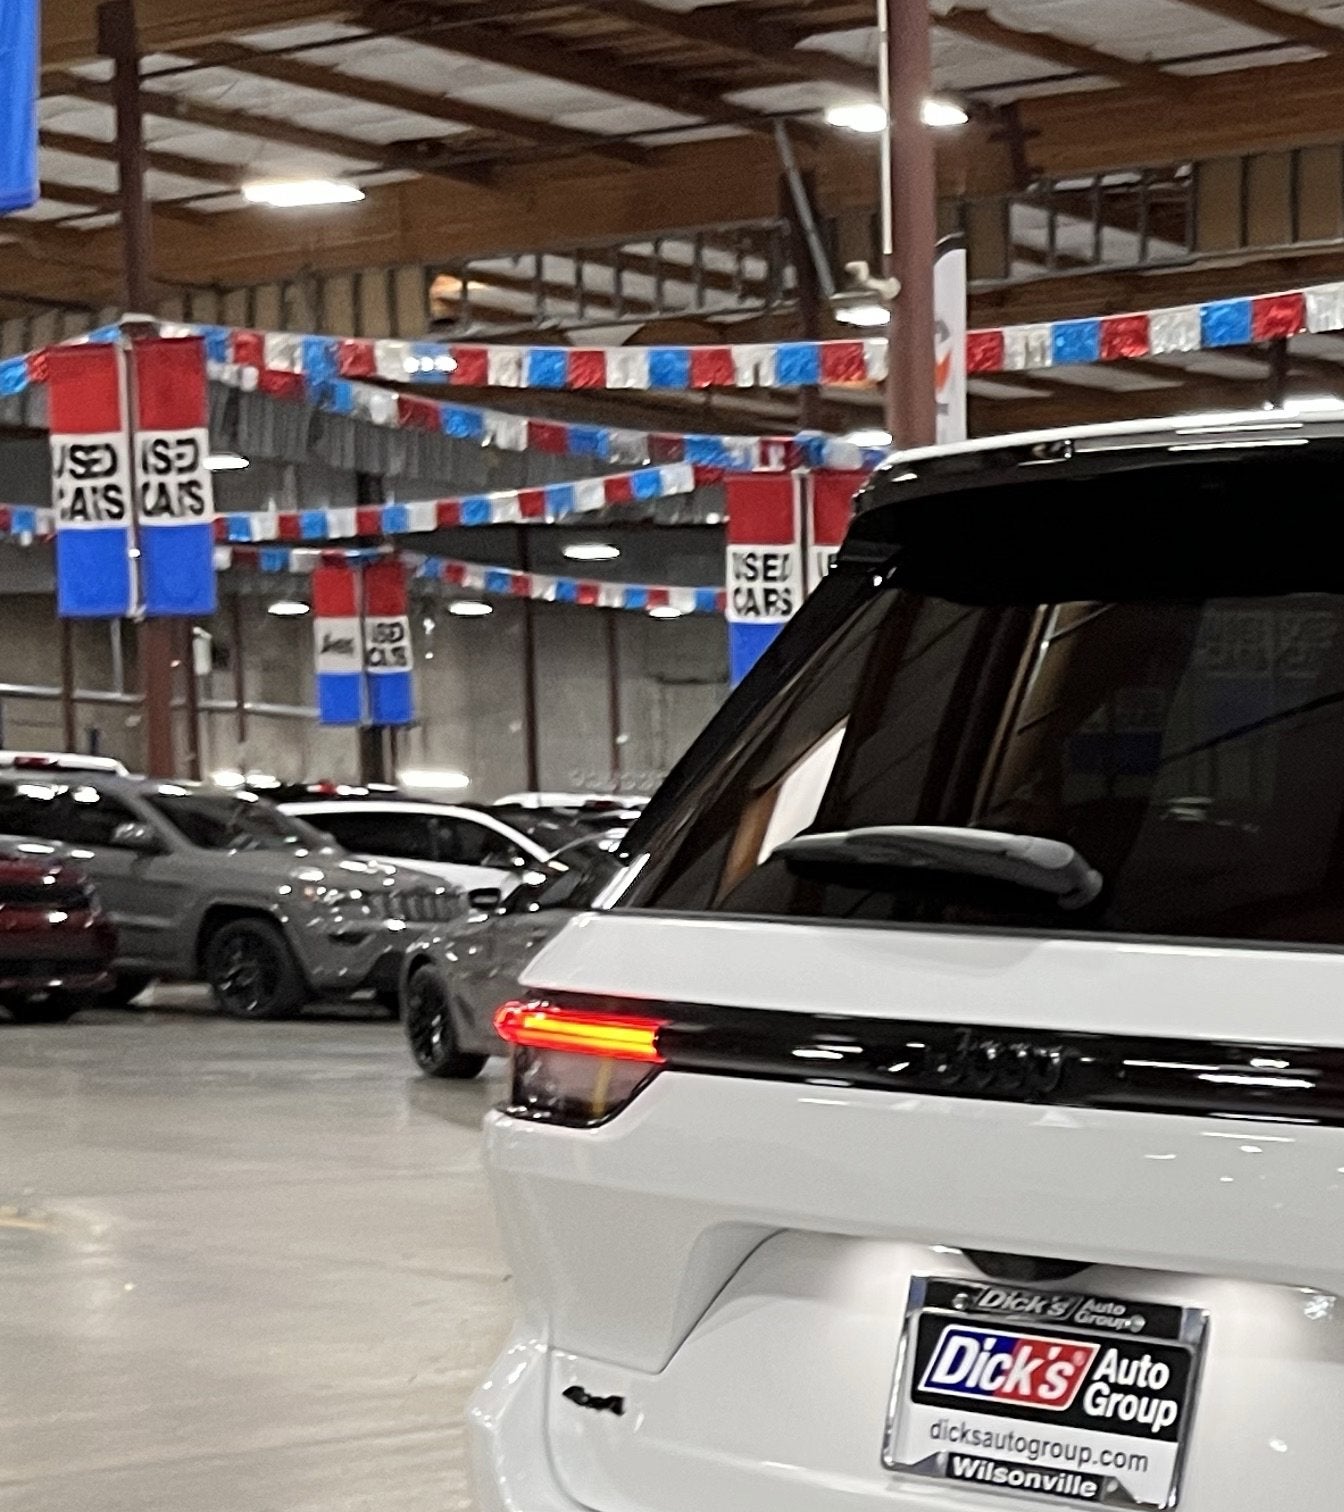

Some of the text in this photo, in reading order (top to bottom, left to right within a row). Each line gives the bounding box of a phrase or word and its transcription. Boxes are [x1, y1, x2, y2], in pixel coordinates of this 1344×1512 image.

[1081, 1299, 1126, 1315] Auto
[930, 1334, 1170, 1400] Dick's Auto
[1083, 1381, 1178, 1433] Group
[930, 1419, 1148, 1473] dicksautogroup.com
[952, 1455, 1098, 1498] Wilsonville
